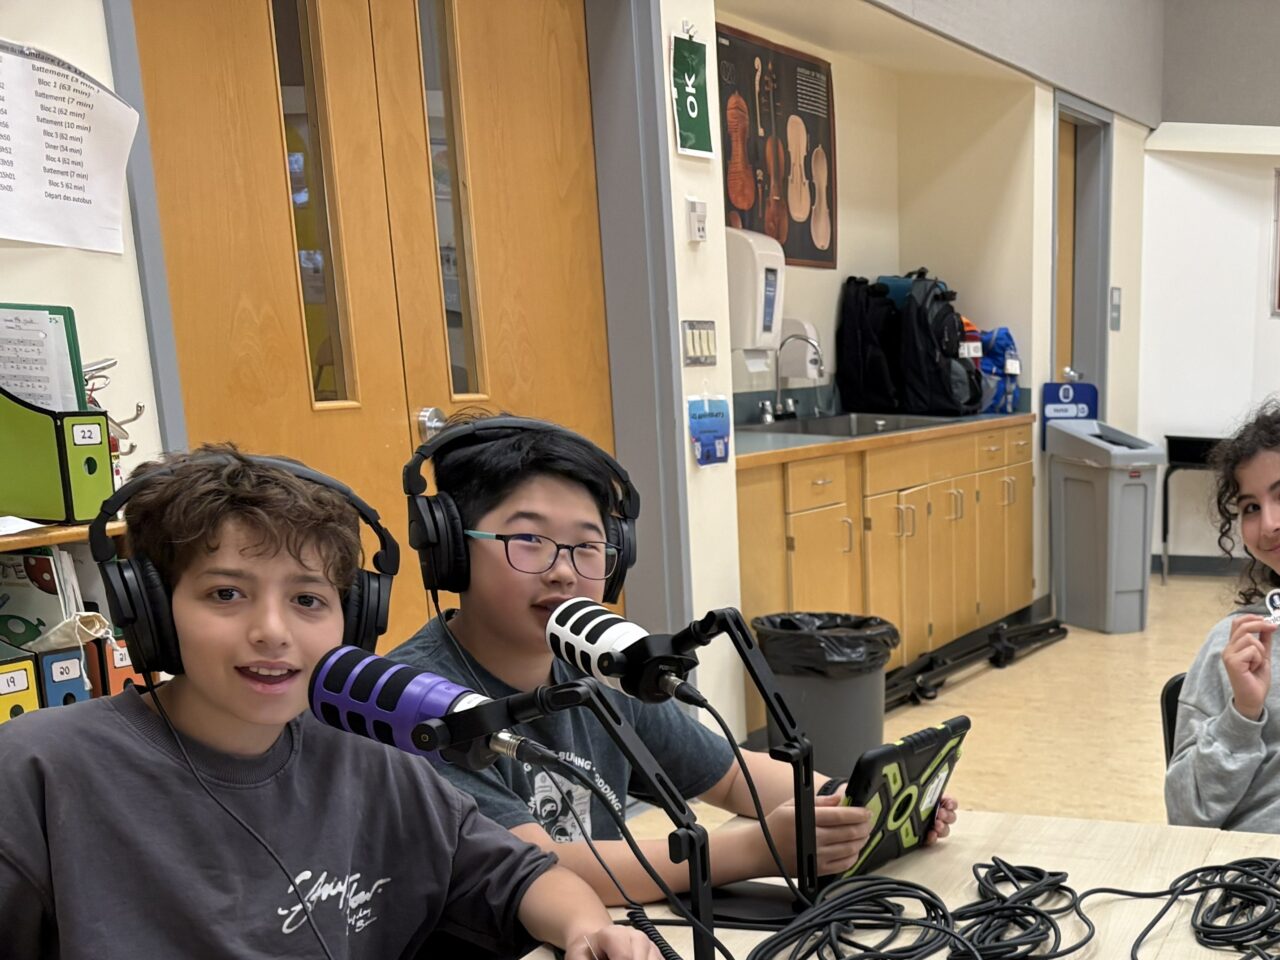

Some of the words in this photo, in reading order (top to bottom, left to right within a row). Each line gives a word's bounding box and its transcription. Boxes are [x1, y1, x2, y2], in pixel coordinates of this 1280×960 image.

[38, 78, 51, 87] Bloc
[685, 72, 698, 118] OK
[40, 104, 52, 113] Bloc
[43, 129, 54, 138] Bloc
[46, 154, 57, 163] Bloc
[48, 180, 60, 188] Bloc
[81, 430, 93, 440] 22
[59, 665, 71, 675] 20
[6, 676, 16, 688] 19
